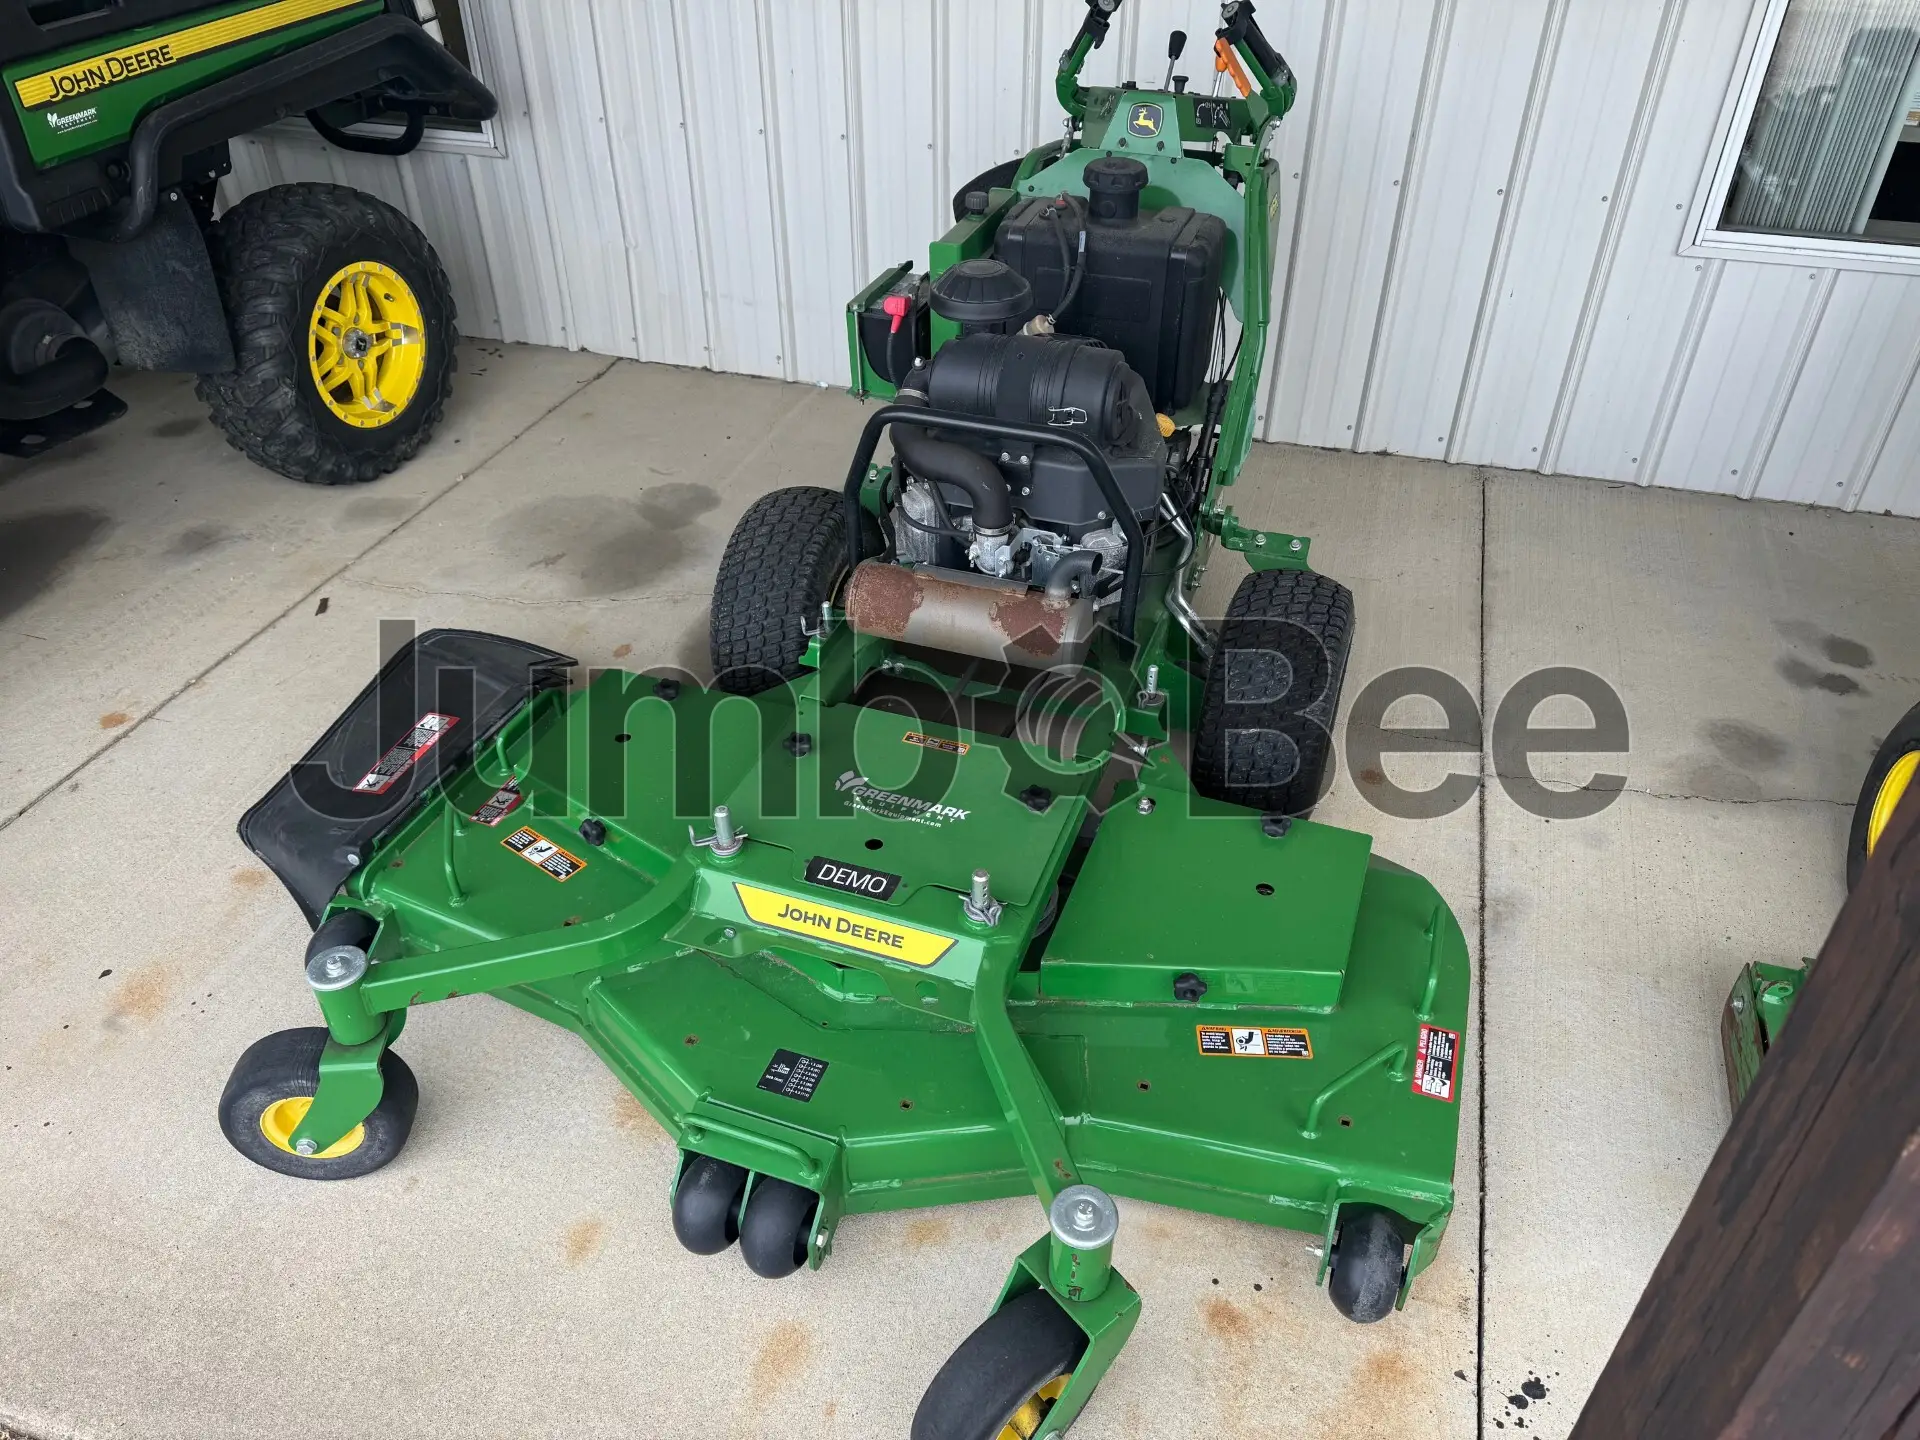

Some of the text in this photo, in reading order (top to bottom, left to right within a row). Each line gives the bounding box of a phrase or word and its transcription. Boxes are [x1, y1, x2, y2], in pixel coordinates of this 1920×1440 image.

[49, 44, 174, 99] JOHN DEERE
[56, 107, 97, 126] GREENMARK
[851, 786, 971, 820] GREENMARK
[817, 863, 887, 893] DEMO
[777, 903, 905, 949] JOHN DEERE
